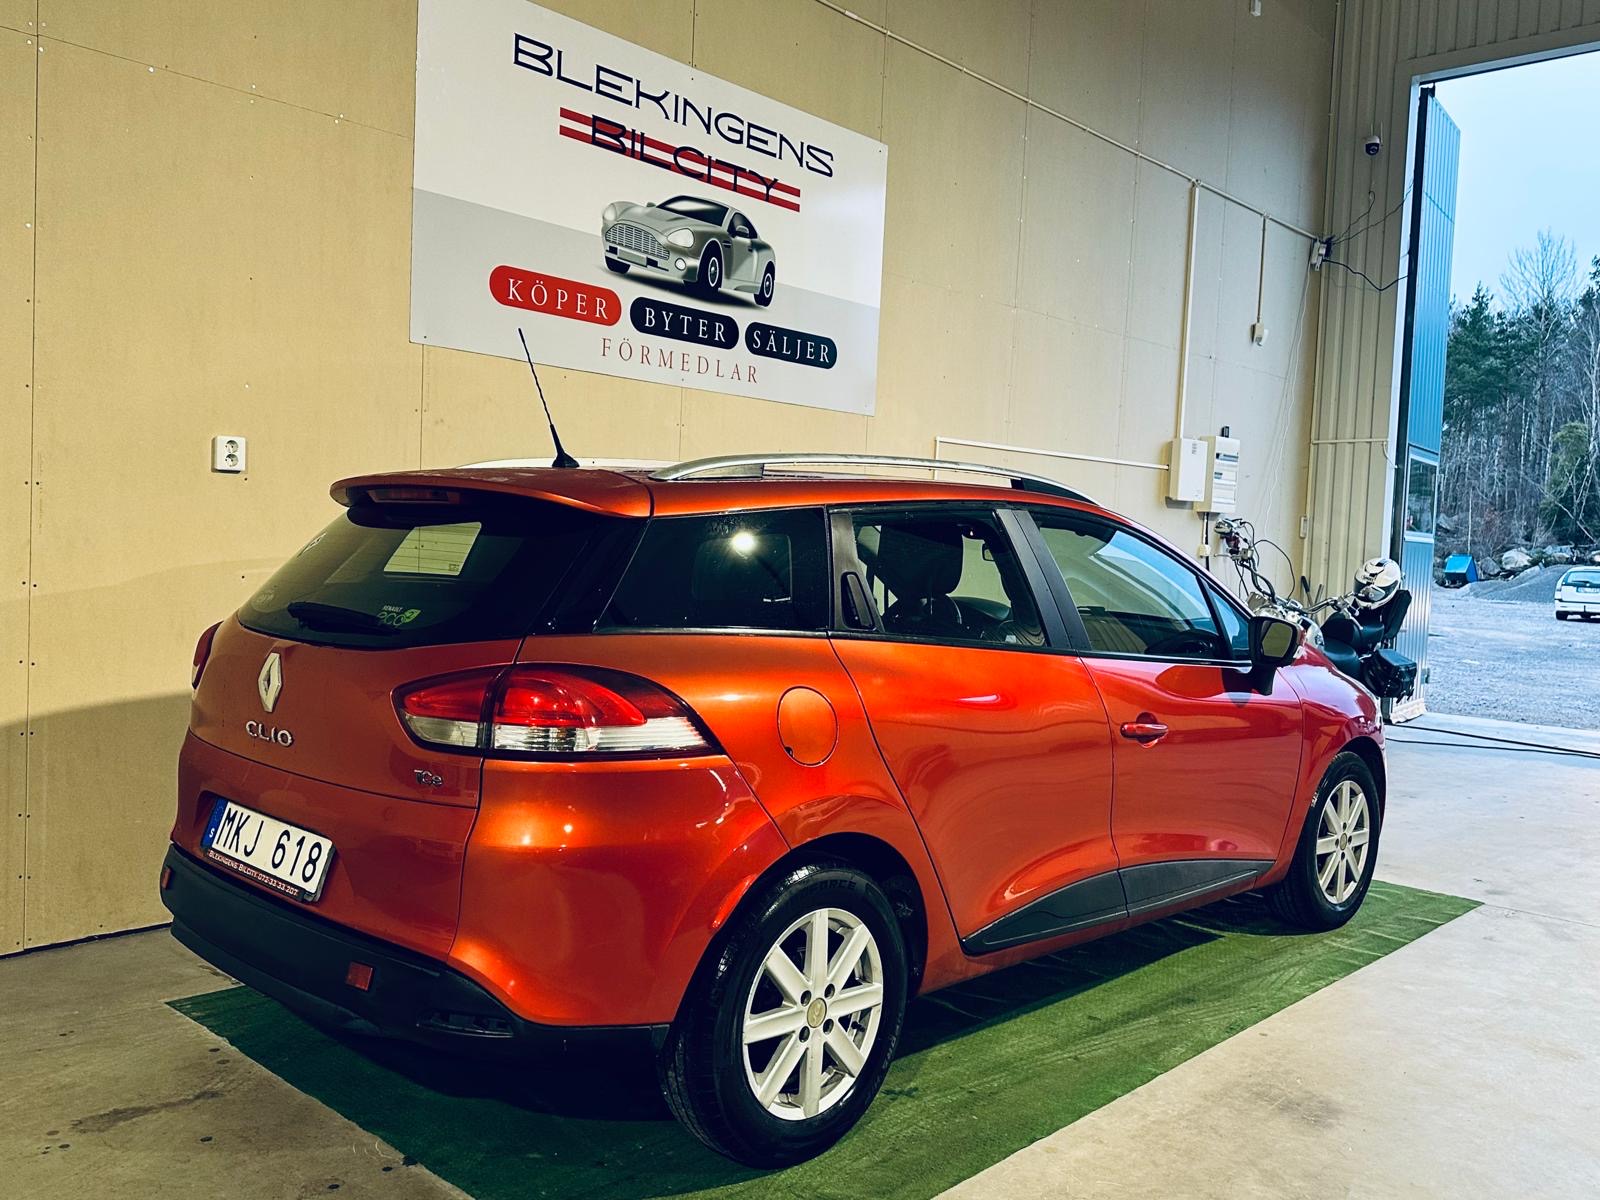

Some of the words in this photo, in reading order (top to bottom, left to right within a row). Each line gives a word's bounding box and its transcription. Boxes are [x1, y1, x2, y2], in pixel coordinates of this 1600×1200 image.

[513, 33, 834, 178] BLEKINGENS
[590, 114, 779, 202] BILCITY
[507, 278, 608, 320] KÖPER
[645, 306, 726, 343] BYTER
[601, 337, 758, 384] FÖRMEDLAR
[752, 329, 830, 363] SÄLJER
[245, 720, 293, 747] CLIO
[209, 828, 215, 838] S
[216, 807, 264, 857] MKJ
[271, 830, 322, 883] 618
[208, 849, 238, 869] BLEKINGENS
